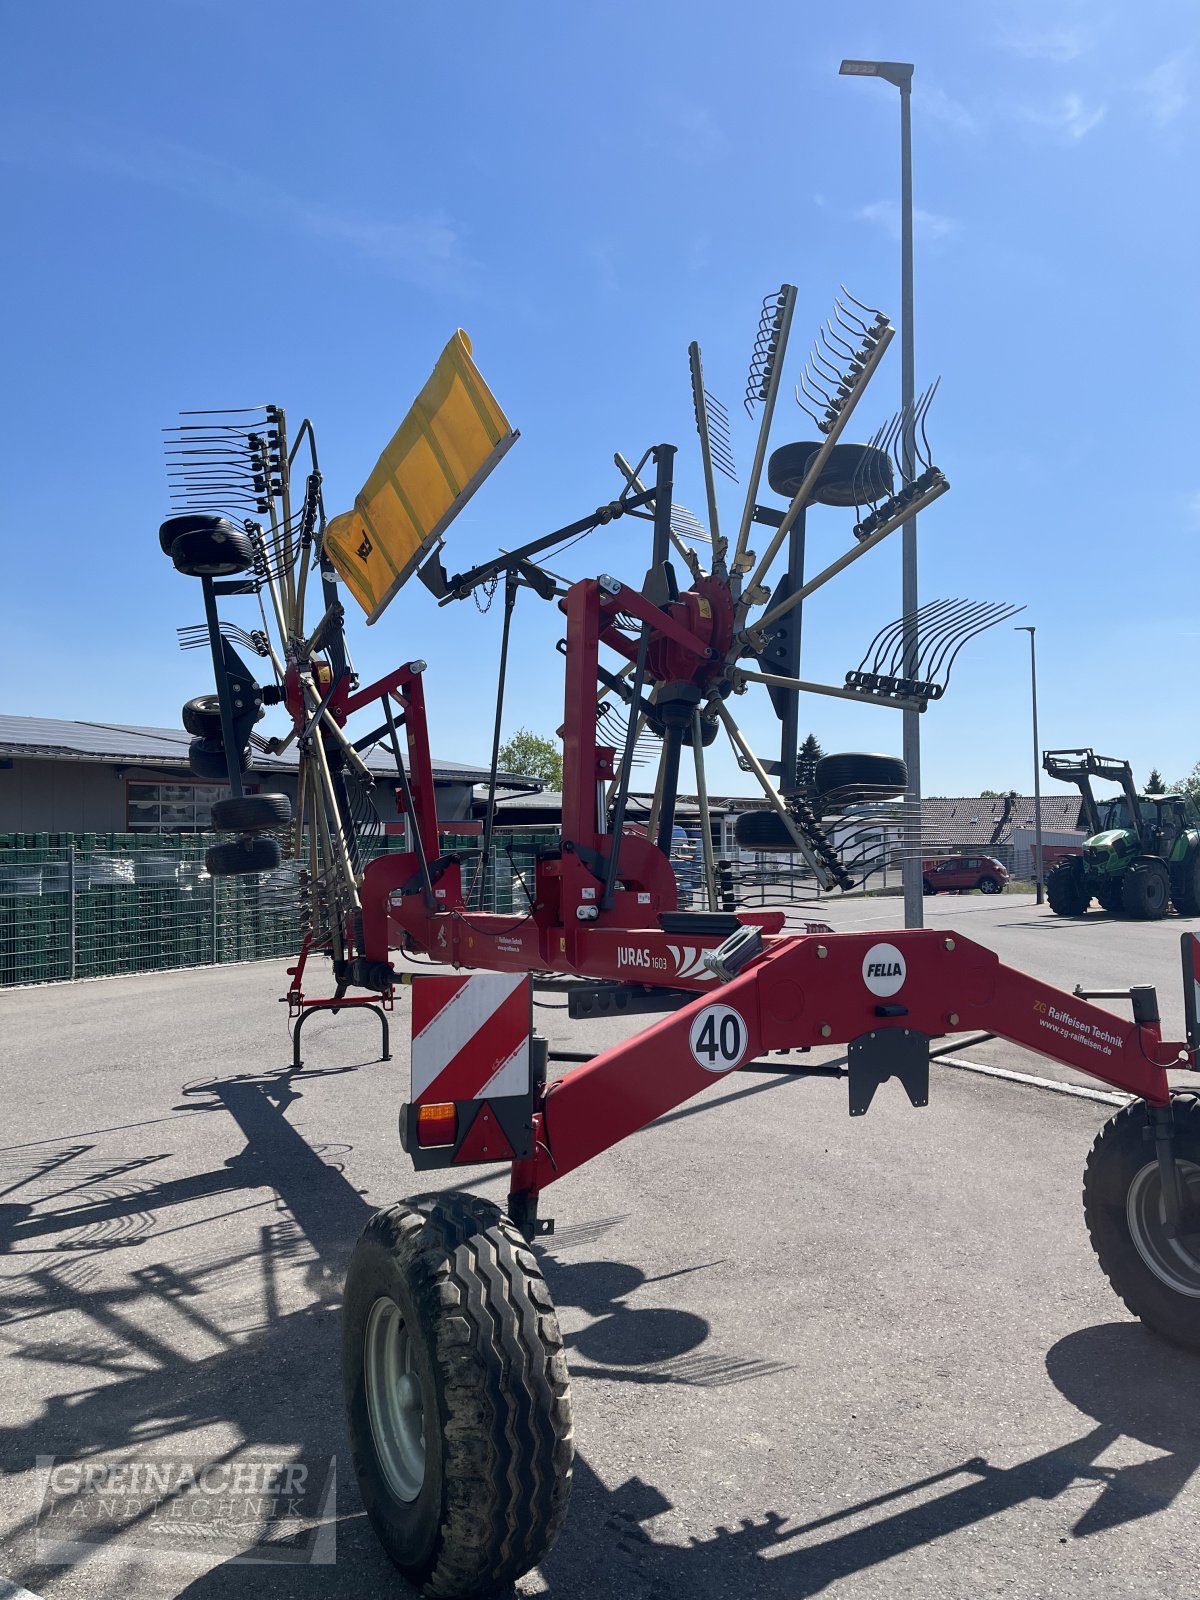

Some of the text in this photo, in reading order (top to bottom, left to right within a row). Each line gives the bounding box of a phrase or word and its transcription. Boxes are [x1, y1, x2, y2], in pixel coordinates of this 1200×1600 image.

[617, 946, 668, 970] JURAS 1603
[867, 962, 902, 978] FELLA
[696, 1014, 740, 1061] 40
[1033, 1000, 1123, 1047] ZG Raiffeisen Technik
[1039, 1019, 1111, 1055] www.zg-raiffeisen.de
